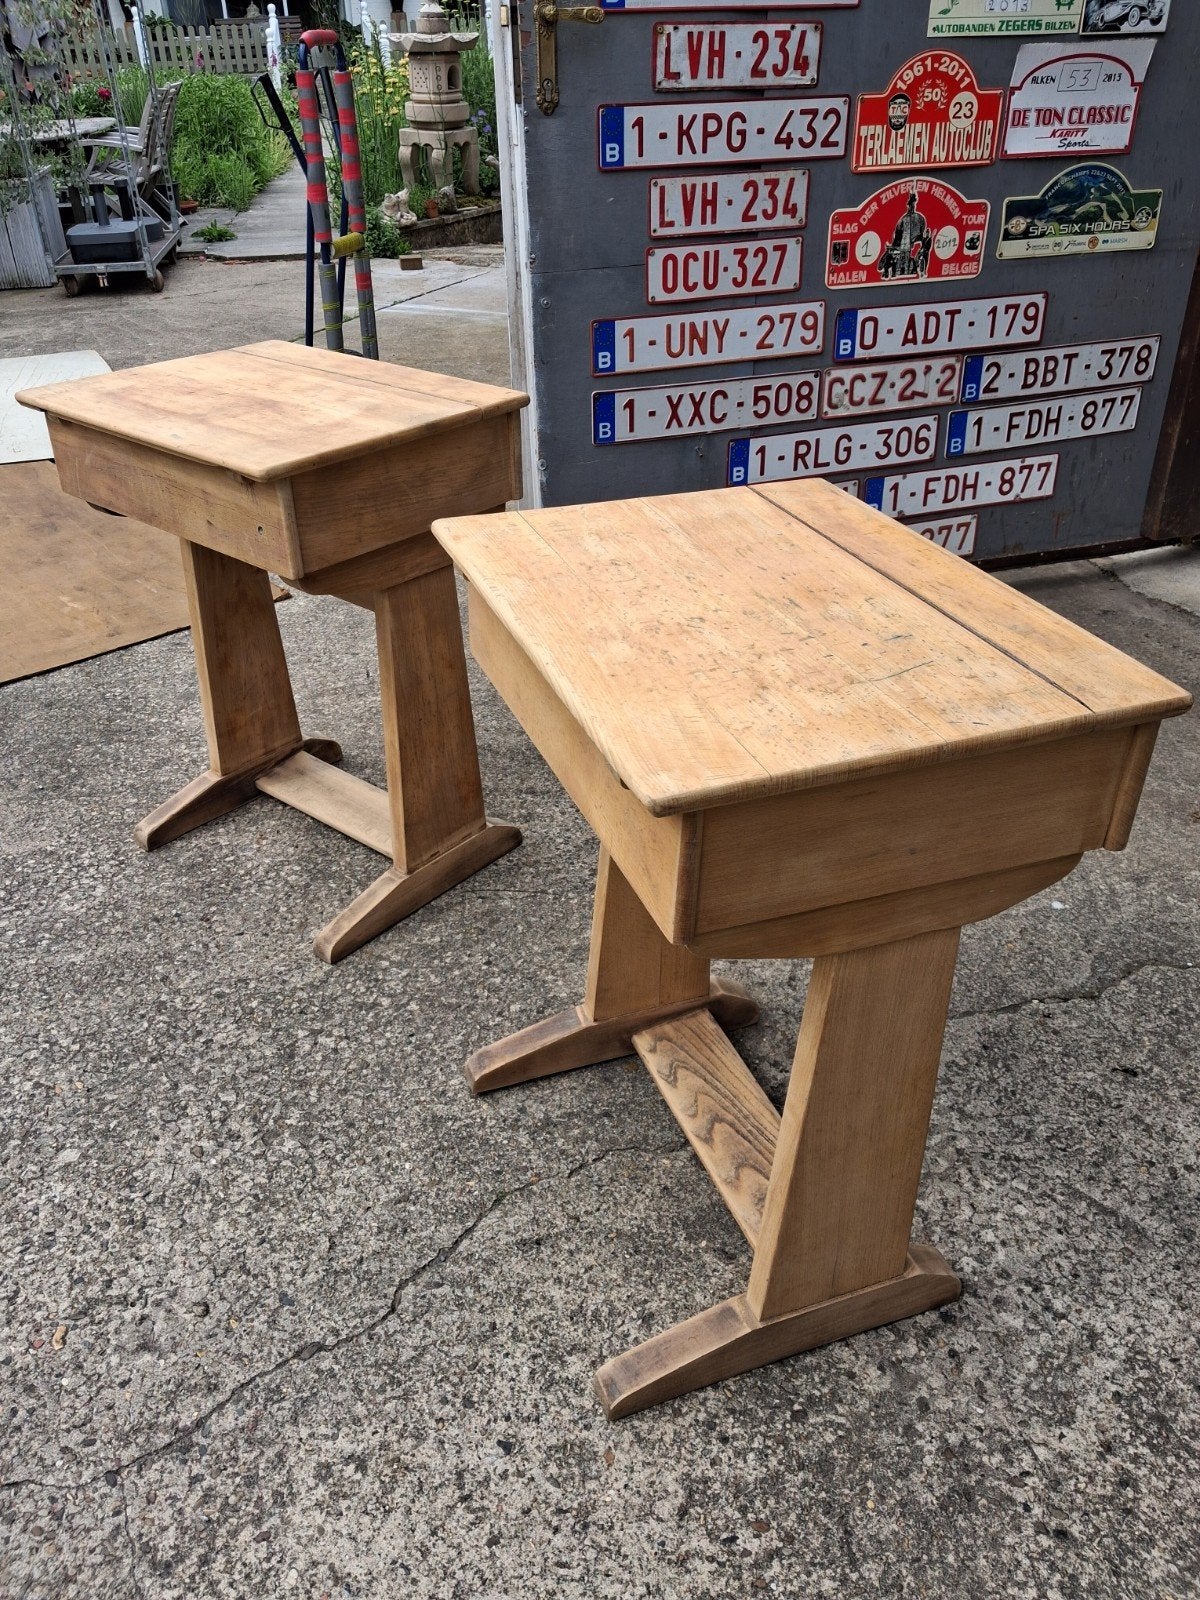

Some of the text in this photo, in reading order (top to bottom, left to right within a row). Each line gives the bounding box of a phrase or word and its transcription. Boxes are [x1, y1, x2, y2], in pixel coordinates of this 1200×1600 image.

[935, 19, 1074, 33] AUTOBANDEN ZEGERS BILZEN
[896, 56, 972, 90] 1961-2011
[1030, 76, 1056, 84] ALKEN
[1066, 69, 1092, 88] 53
[1102, 73, 1122, 82] 2013
[924, 88, 941, 102] 50
[952, 102, 974, 120] 23
[1010, 104, 1132, 128] DE TON CLASSIC
[632, 108, 842, 158] 1-KPG-432
[860, 120, 994, 165] TERLAEMEN AUTOCLUB
[1058, 138, 1091, 150] Sports
[606, 143, 620, 162] B
[860, 202, 879, 226] DER
[931, 184, 962, 220] HELMEN
[962, 214, 986, 225] TOUR
[832, 223, 858, 234] SLAG
[1028, 226, 1056, 237] SPA
[1060, 224, 1081, 234] SIX
[1085, 220, 1131, 232] HOURS
[862, 239, 872, 258] 1
[828, 270, 866, 284] HALEN
[622, 310, 820, 362] 1-UNY-279
[840, 340, 852, 355] B
[598, 352, 610, 369] B
[982, 344, 1152, 395] 2-BBT-378
[965, 384, 977, 400] B
[622, 380, 814, 433] 1-XXC-508
[598, 422, 611, 438] B
[972, 395, 1136, 448] 1-FDH-877
[755, 428, 932, 476] 1-RLG-306
[950, 437, 962, 453] B
[733, 466, 744, 482] B
[888, 462, 1052, 512] 1-FDH-877
